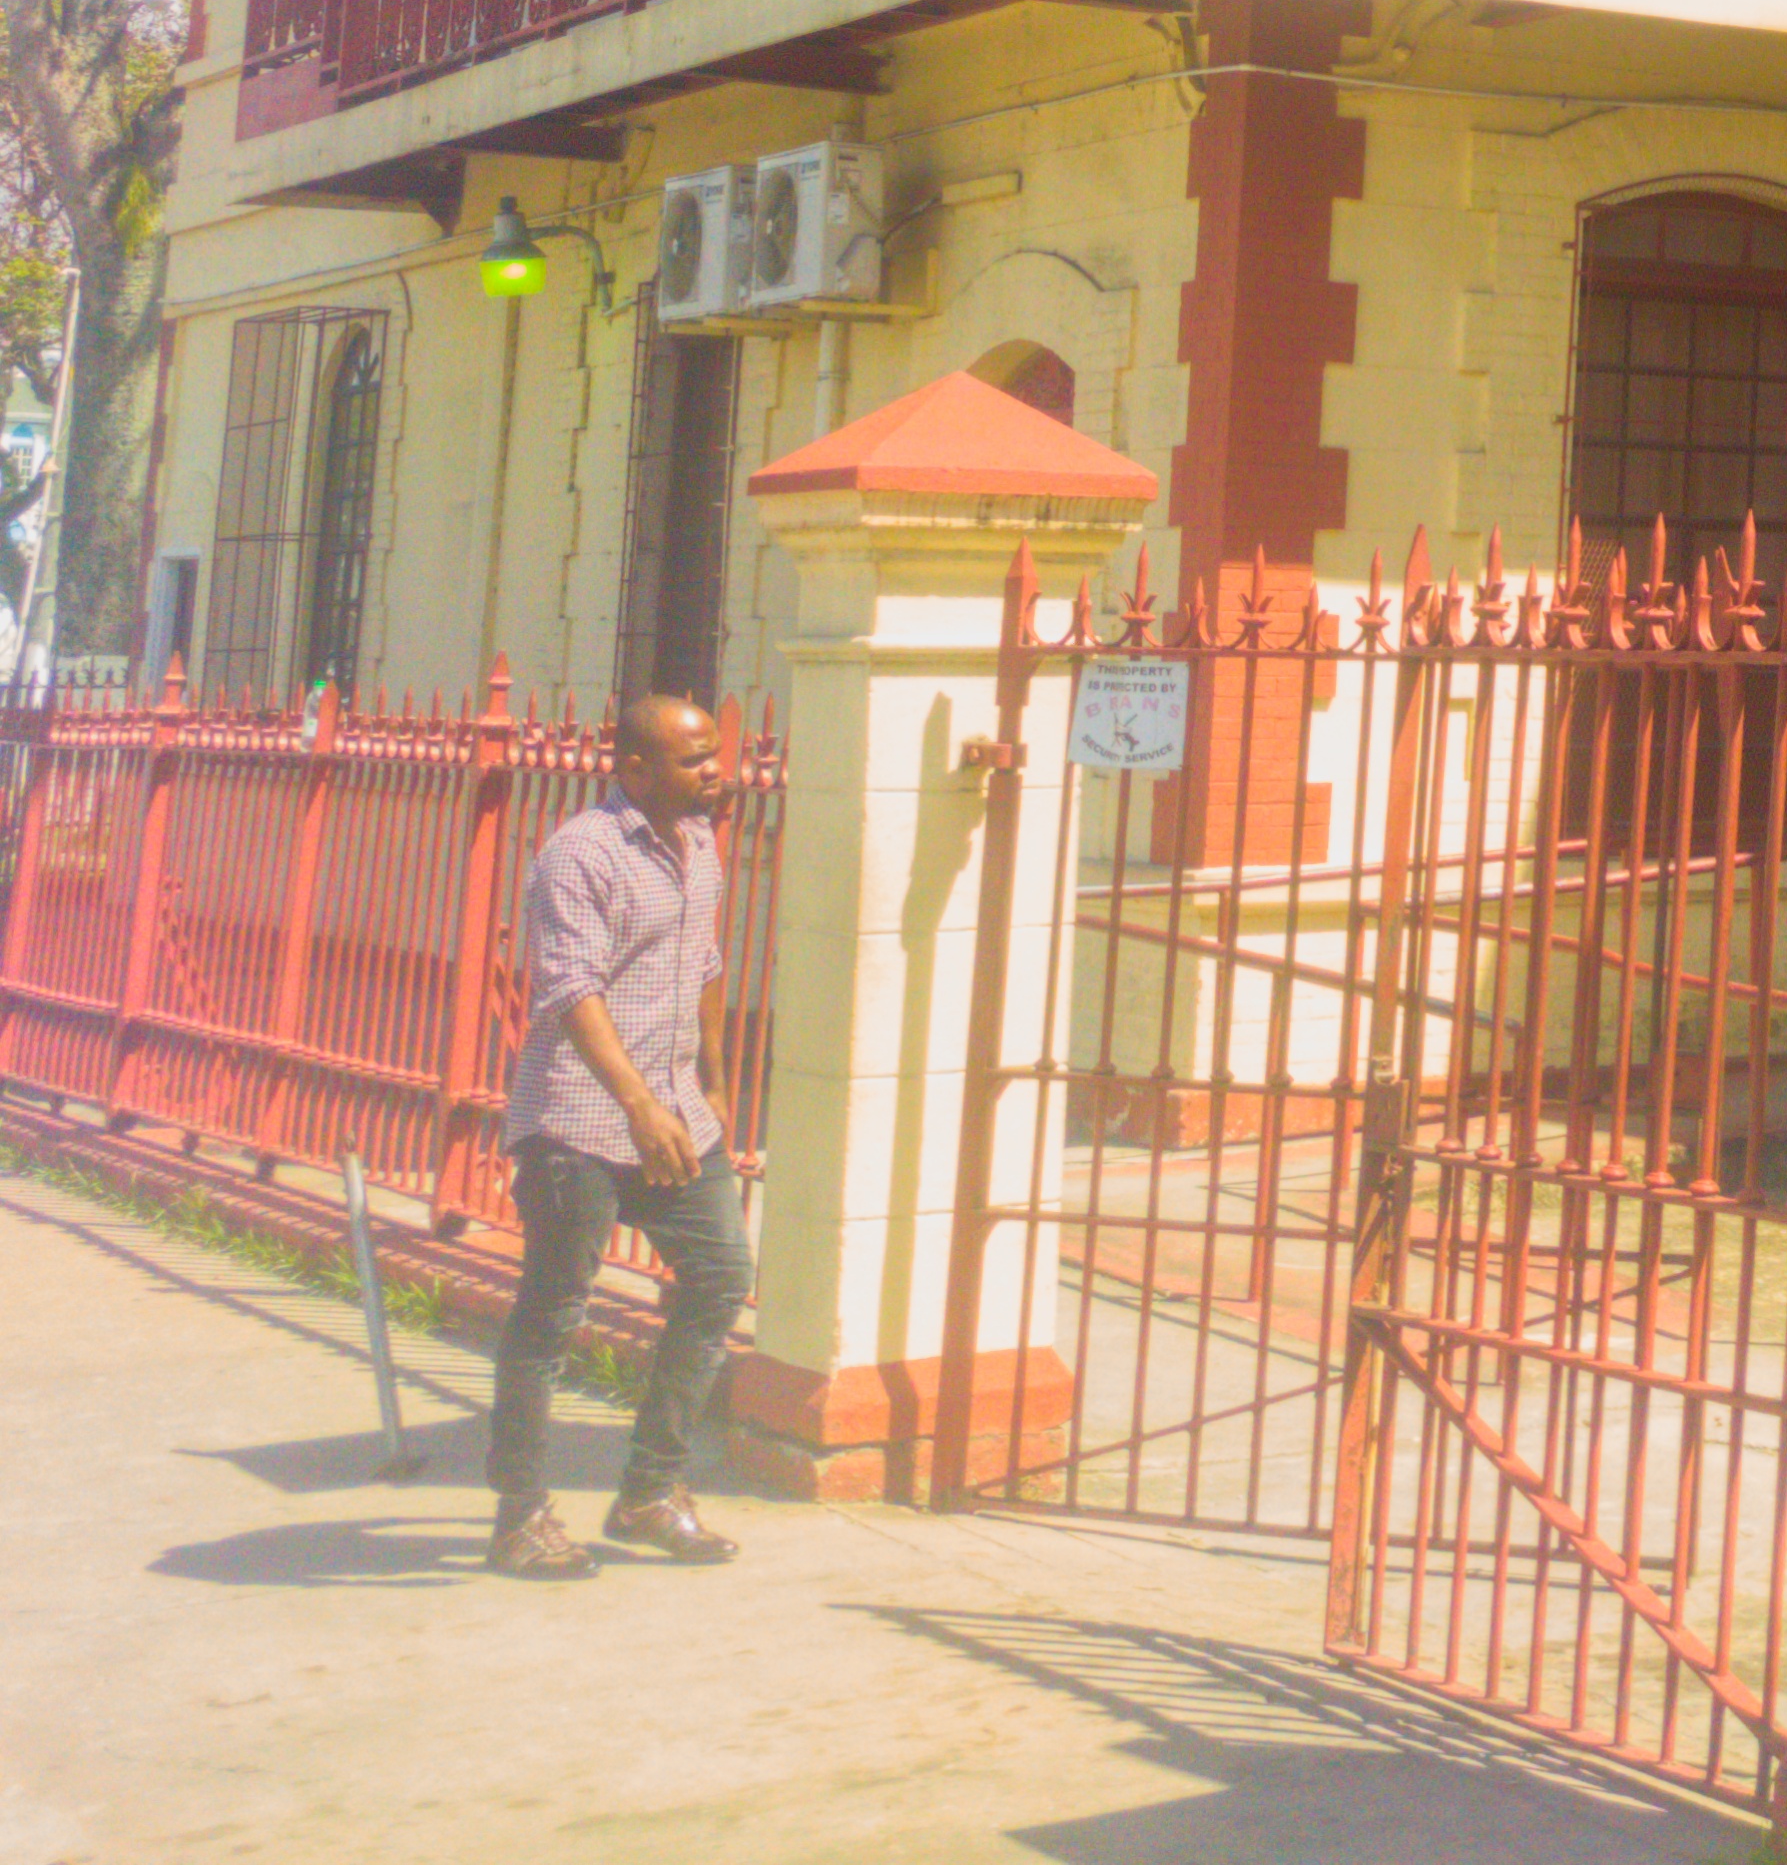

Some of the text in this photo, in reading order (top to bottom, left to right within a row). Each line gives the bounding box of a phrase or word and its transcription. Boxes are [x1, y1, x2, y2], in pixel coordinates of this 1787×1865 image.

[1088, 680, 1101, 690] IS
[1161, 683, 1177, 693] BY
[1124, 742, 1174, 763] SERVICE
